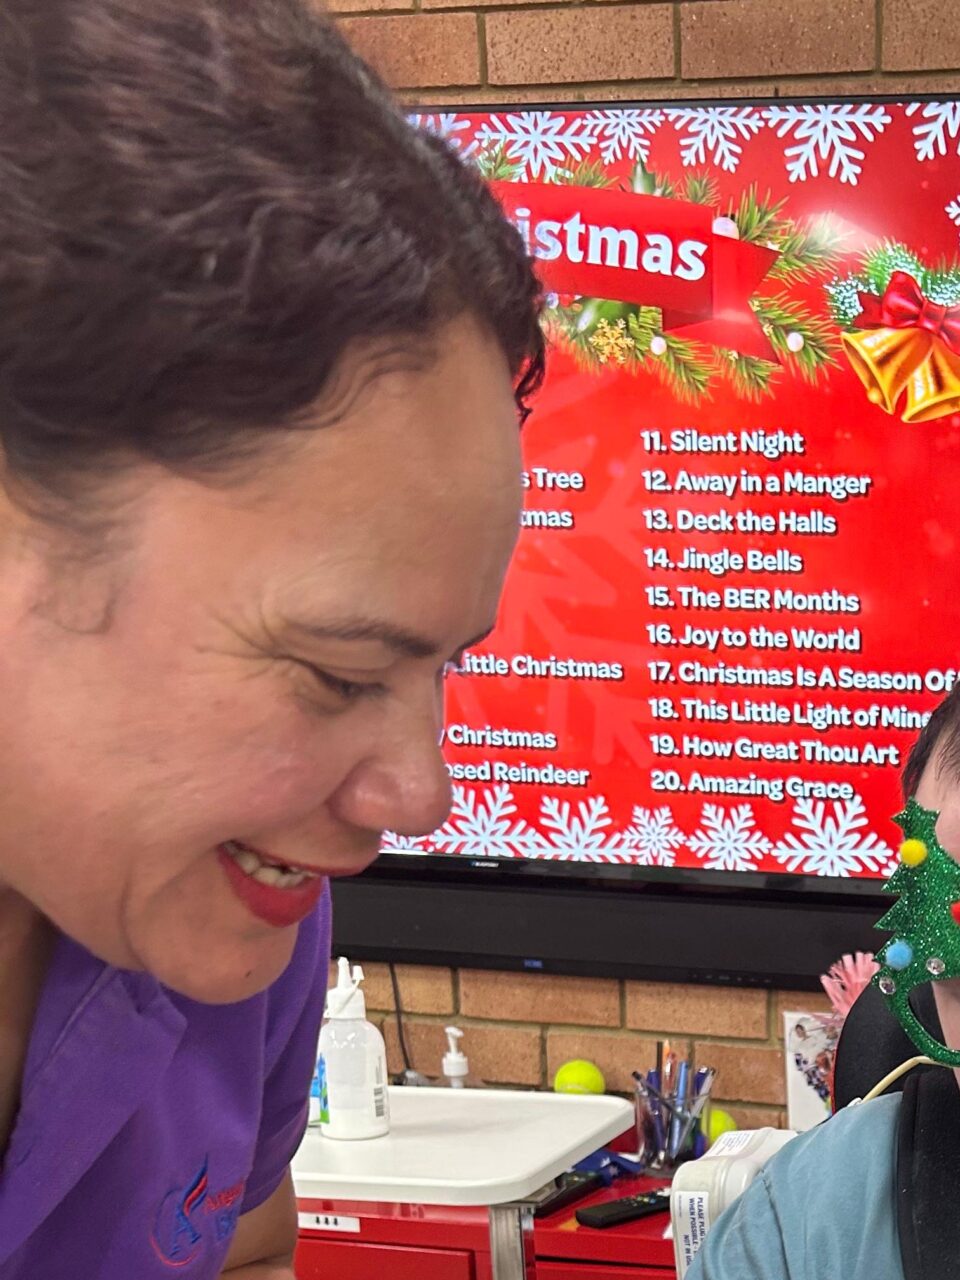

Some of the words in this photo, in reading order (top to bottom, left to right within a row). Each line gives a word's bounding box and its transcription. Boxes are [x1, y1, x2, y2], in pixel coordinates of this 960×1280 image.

[515, 208, 708, 280] istmas
[641, 430, 667, 451] 11.
[671, 430, 737, 451] Silent
[741, 430, 804, 458] Night
[533, 467, 583, 488] Tree
[642, 470, 671, 490] 12.
[675, 471, 737, 497] Away
[741, 470, 762, 491] in
[766, 477, 780, 492] a
[784, 472, 871, 499] Manger
[643, 510, 673, 530] 13.
[677, 510, 733, 531] Deck
[737, 510, 775, 531] the
[779, 511, 836, 532] Halls
[644, 548, 674, 568] 14.
[678, 548, 743, 574] Jingle
[747, 549, 802, 571] Bells
[645, 587, 674, 606] 15.
[677, 587, 720, 608] The
[724, 589, 771, 609] BER
[774, 589, 860, 611] Months
[646, 624, 676, 645] 16.
[680, 625, 719, 650] Joy
[722, 629, 746, 647] to
[750, 628, 788, 648] the
[791, 629, 860, 650] World
[512, 656, 622, 678] Christmas
[648, 661, 675, 681] 17.
[679, 662, 793, 687] Christmas
[797, 667, 816, 687] Is
[819, 668, 836, 687] A
[839, 669, 921, 690] Season
[925, 670, 955, 692] Of
[649, 698, 679, 719] 18.
[681, 700, 728, 721] This
[732, 702, 790, 723] Little
[794, 704, 851, 729] Light
[854, 708, 879, 727] of
[448, 725, 557, 748] Christmas
[650, 734, 680, 754] 19.
[683, 736, 733, 757] How
[736, 739, 798, 760] Great
[801, 741, 858, 763] Thou
[861, 744, 900, 765] Art
[493, 763, 590, 784] Reindeer
[651, 771, 685, 791] 20.
[689, 773, 783, 800] Amazing
[786, 775, 854, 799] Grace
[691, 1218, 699, 1245] POSSIBLE
